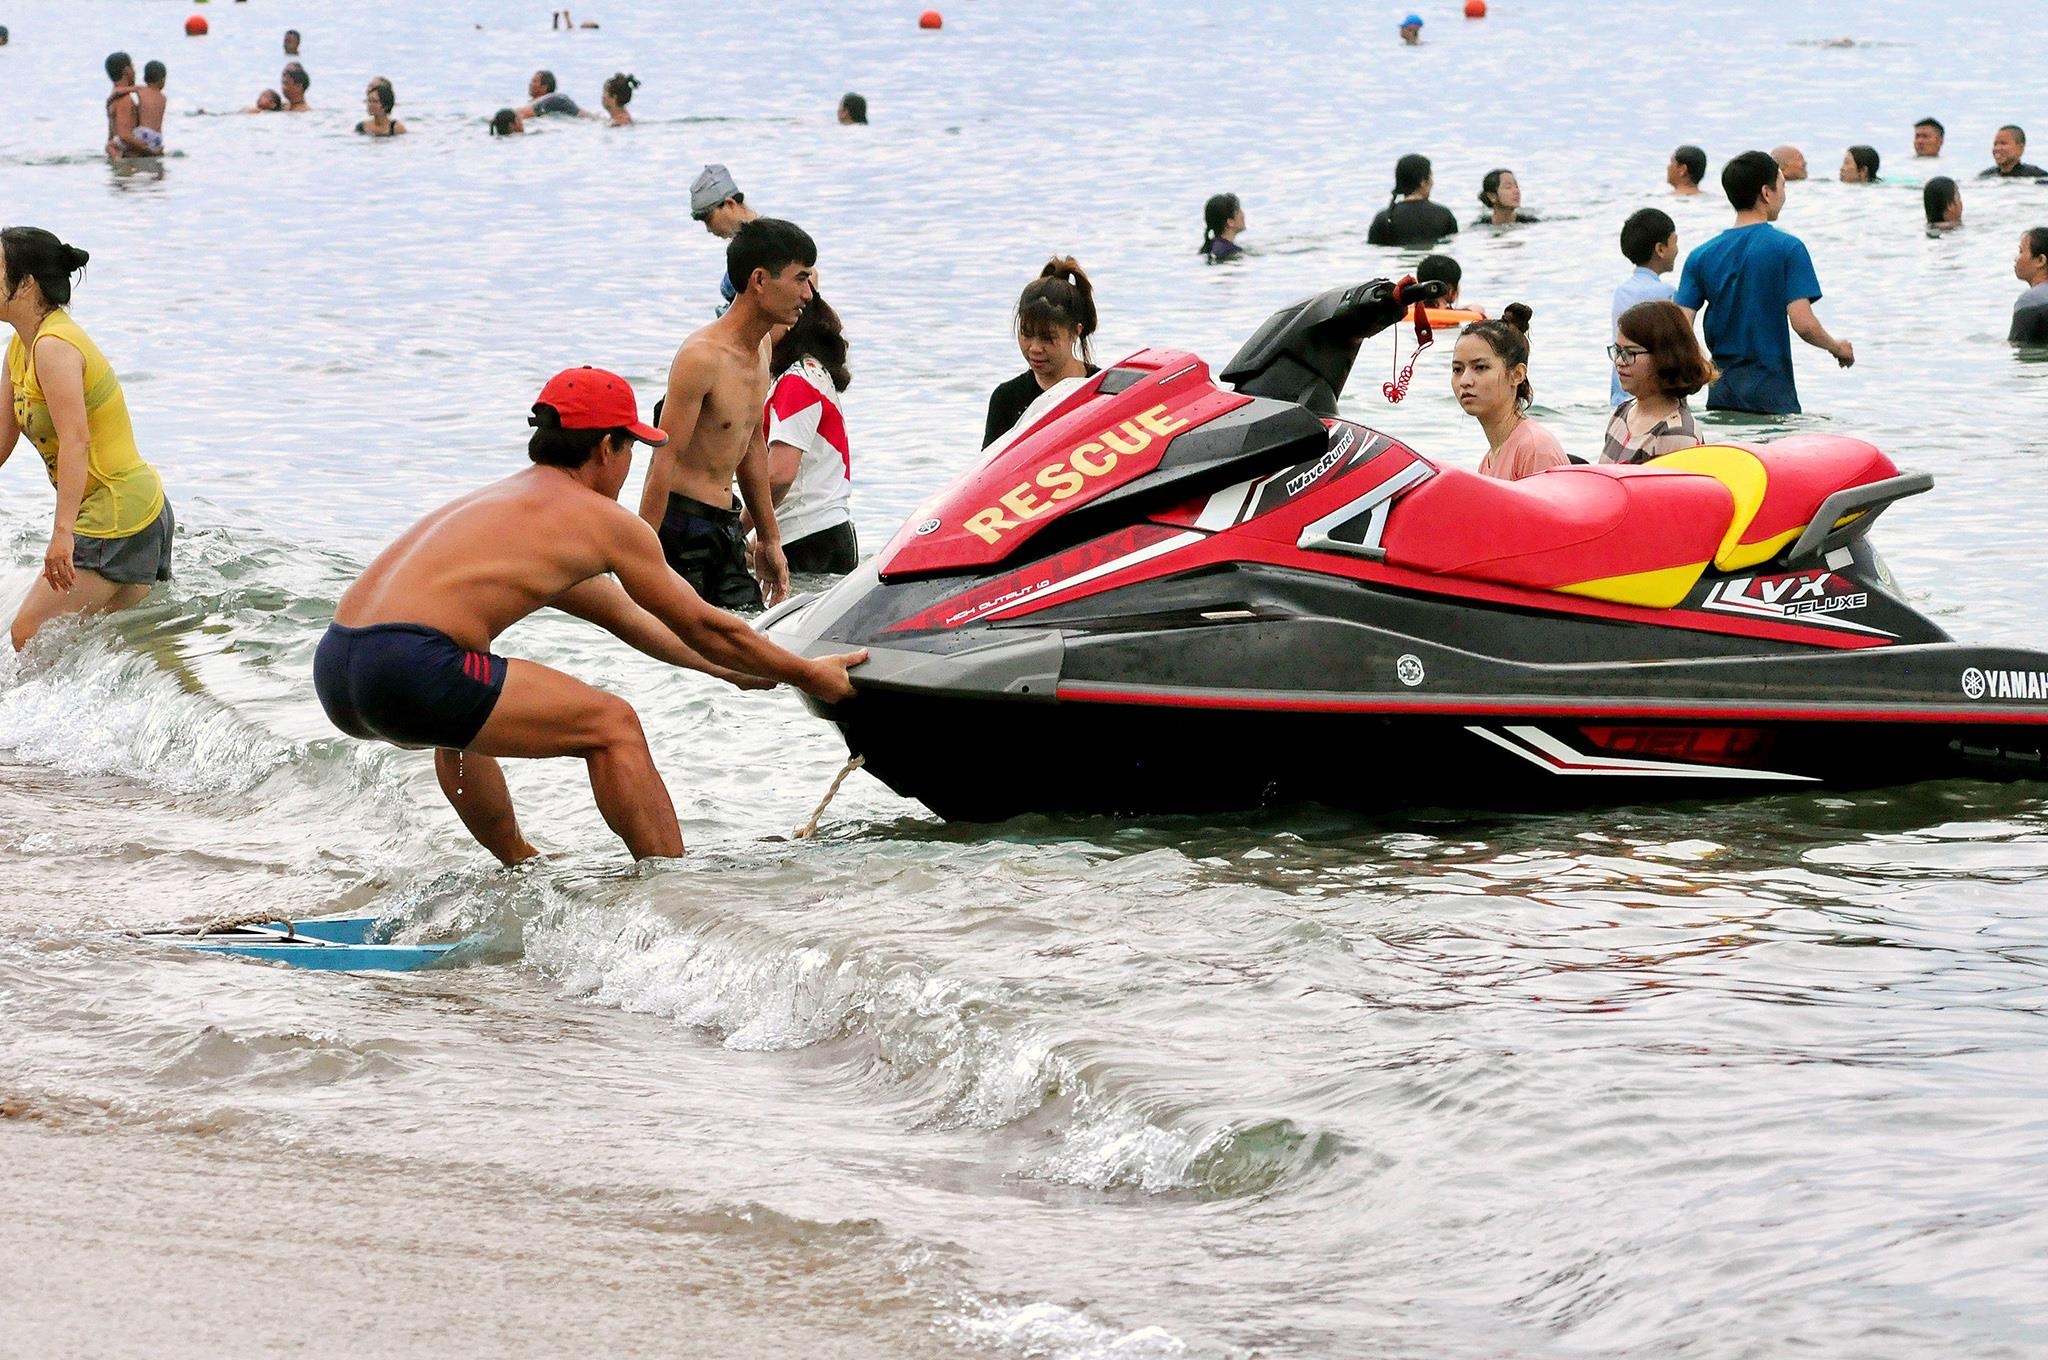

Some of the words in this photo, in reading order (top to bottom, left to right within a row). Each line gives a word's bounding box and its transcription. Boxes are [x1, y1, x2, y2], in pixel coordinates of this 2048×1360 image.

[962, 404, 1189, 545] RESCUE
[1286, 428, 1355, 496] WaveRunner
[945, 607, 976, 624] HIGH
[978, 585, 1034, 611] OUTPUT
[1783, 592, 1868, 617] DELUXE
